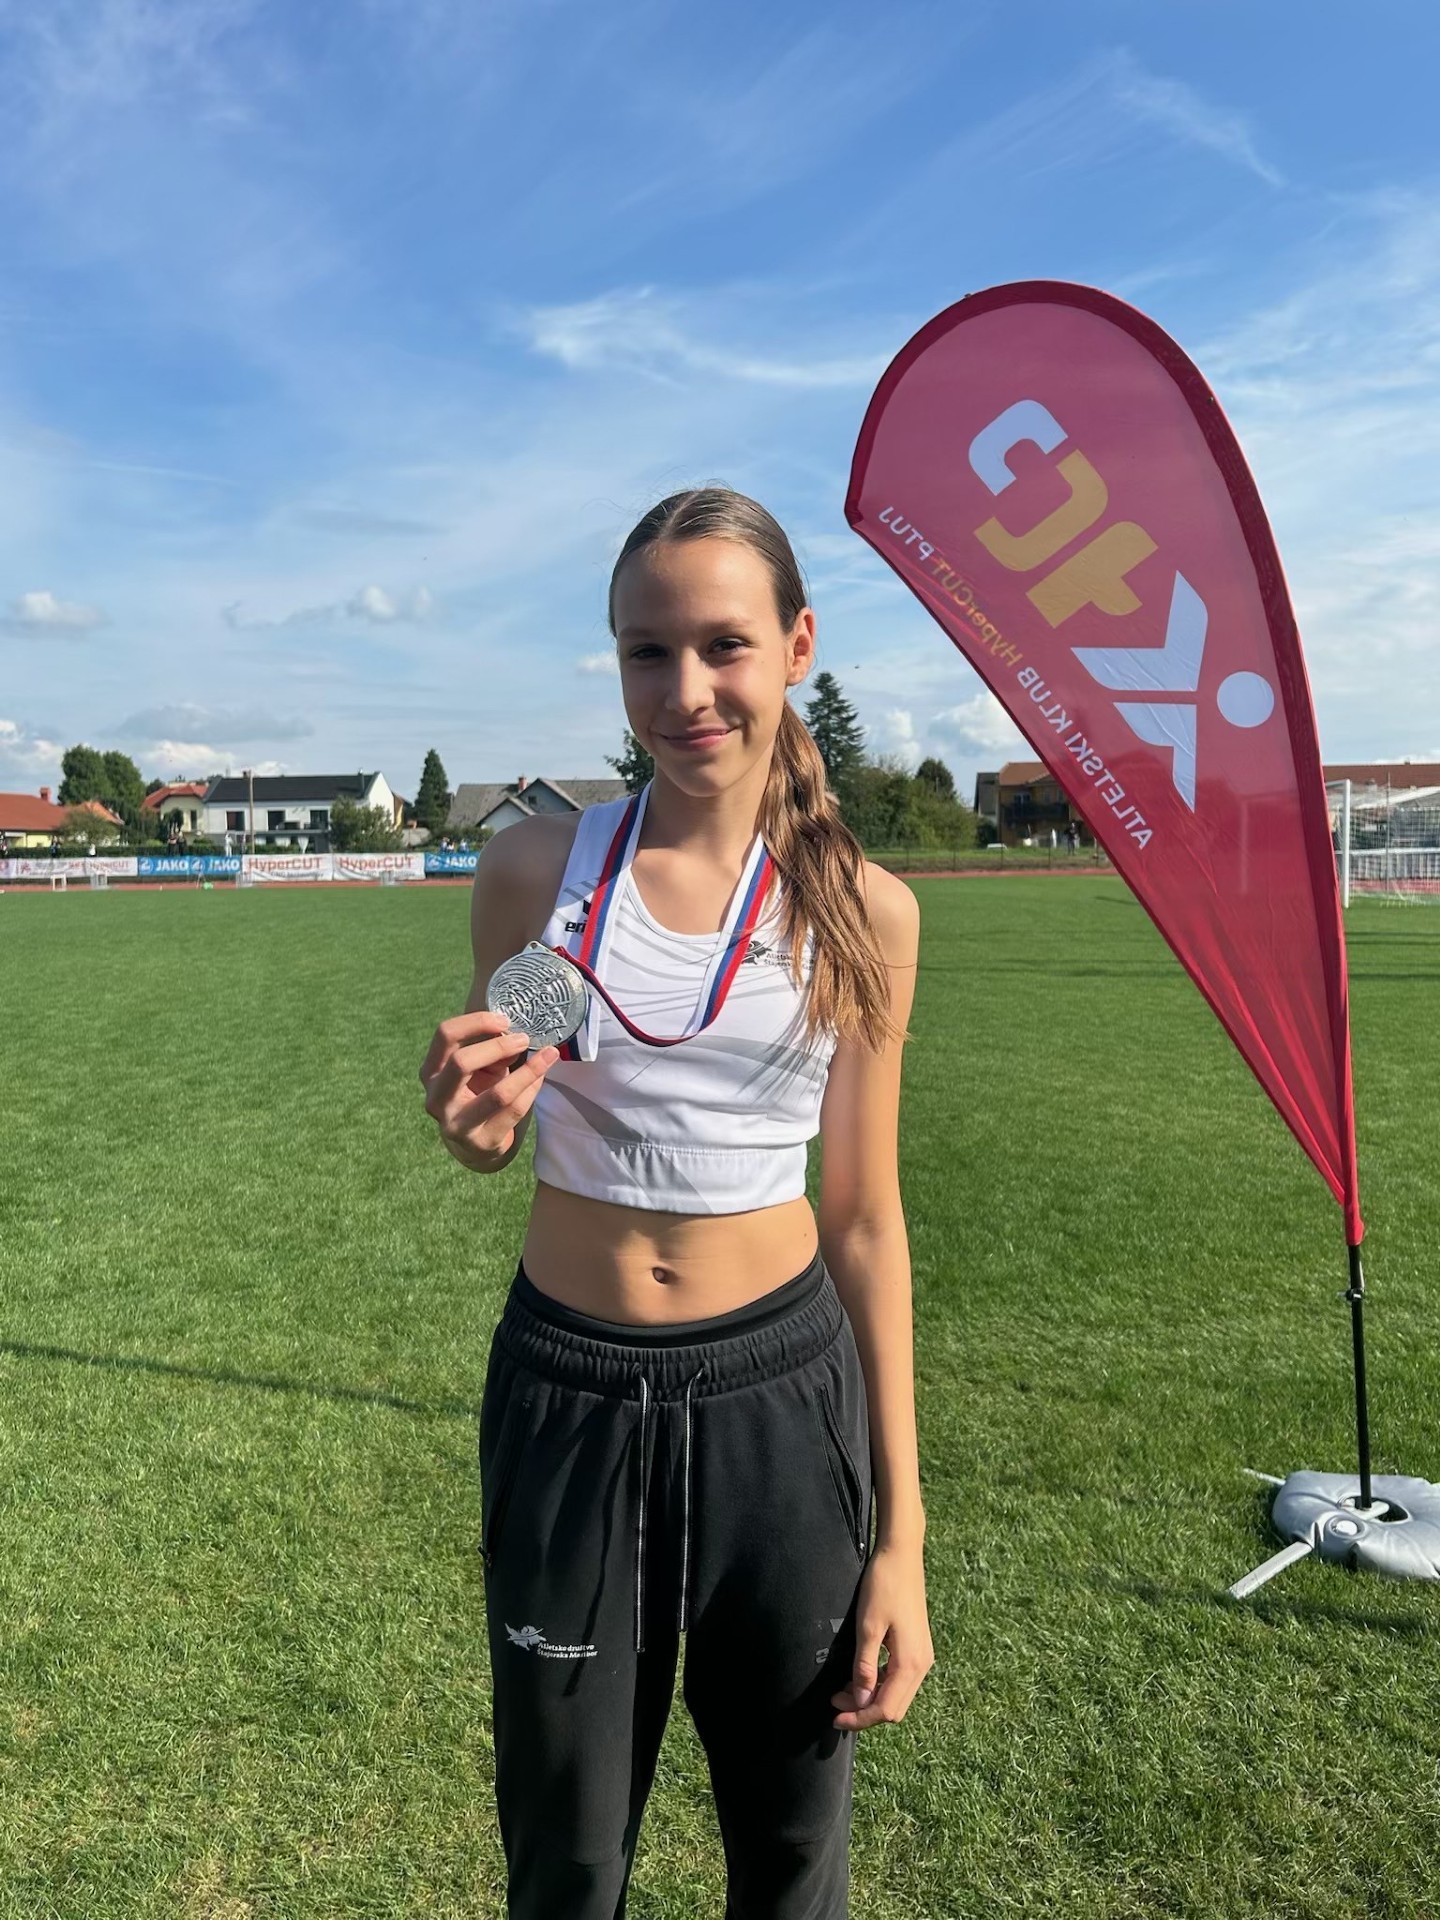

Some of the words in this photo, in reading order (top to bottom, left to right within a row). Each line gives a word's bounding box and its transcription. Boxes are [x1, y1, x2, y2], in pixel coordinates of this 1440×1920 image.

[156, 859, 188, 871] JAKO
[249, 857, 322, 872] HyperCUT
[339, 856, 413, 871] HyperCUT
[445, 856, 477, 868] JAKO
[564, 920, 588, 933] eri
